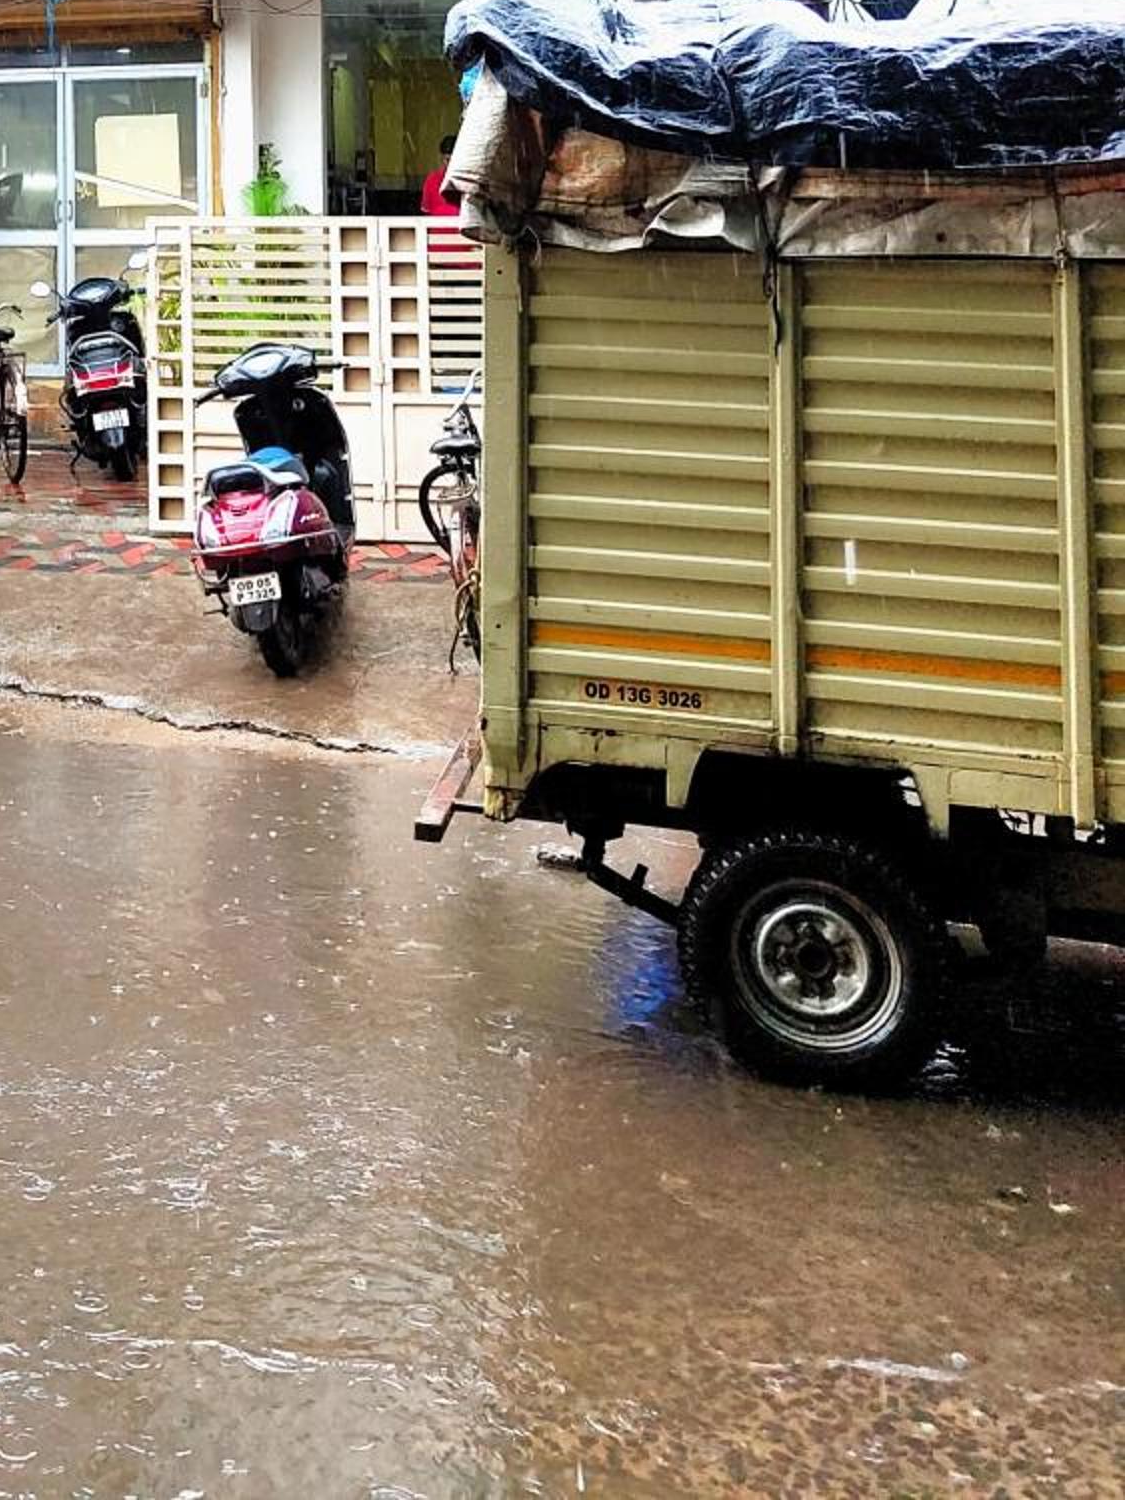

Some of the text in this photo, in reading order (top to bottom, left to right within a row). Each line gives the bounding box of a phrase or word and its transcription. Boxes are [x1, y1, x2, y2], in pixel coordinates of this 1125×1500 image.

[584, 682, 702, 709] OD 13G 3026
